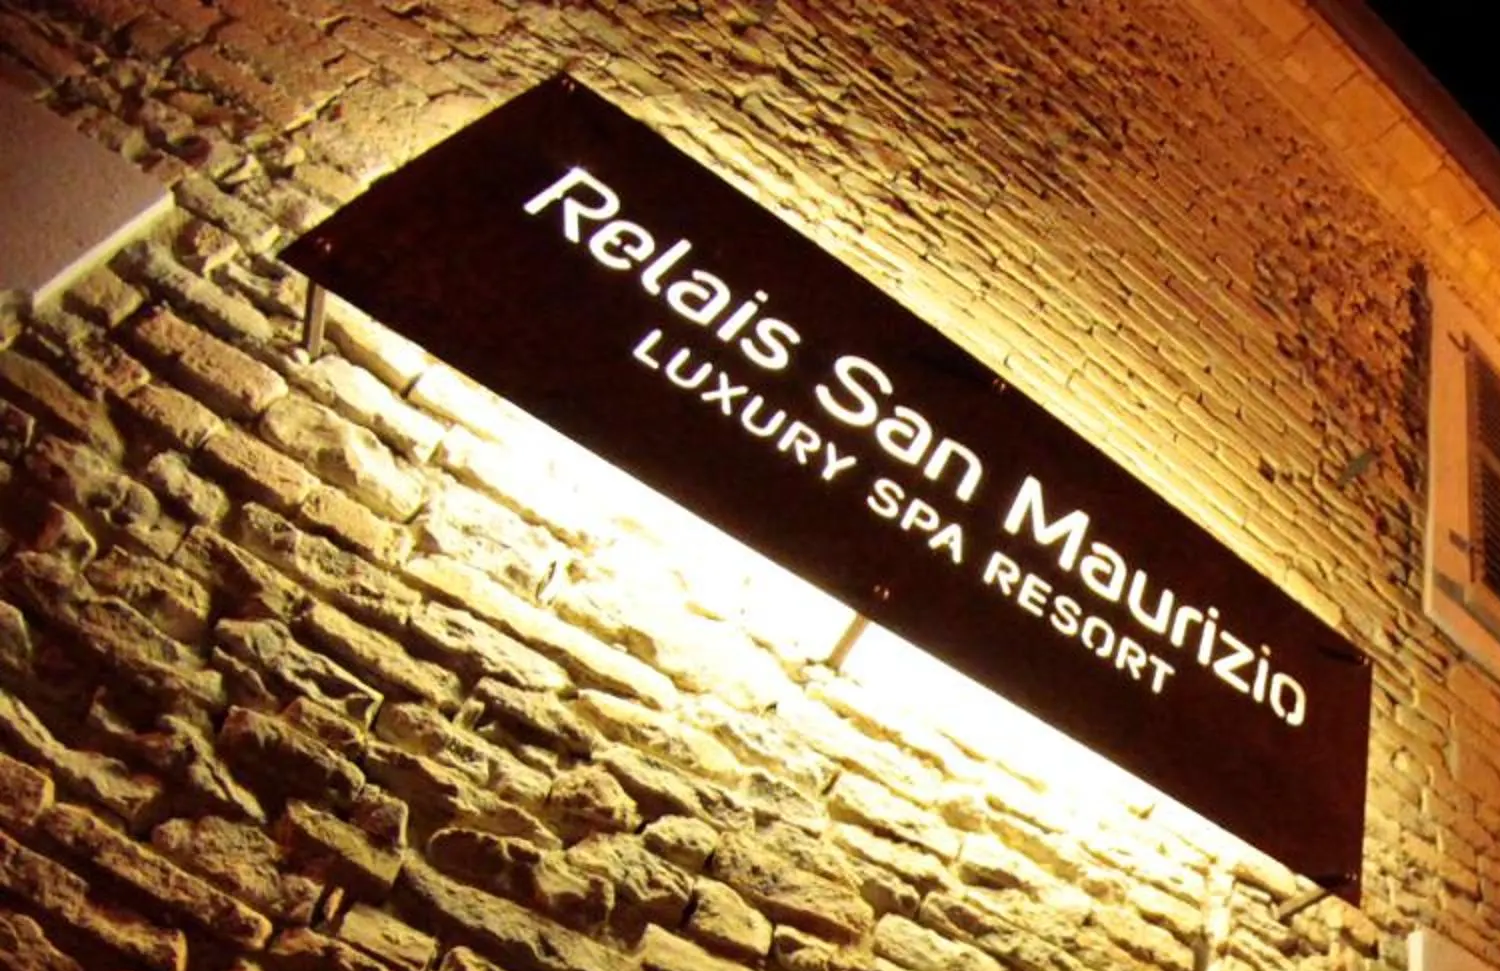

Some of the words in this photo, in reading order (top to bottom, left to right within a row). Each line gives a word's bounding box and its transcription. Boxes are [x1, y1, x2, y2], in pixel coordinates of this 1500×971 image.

[523, 166, 801, 371] Relais
[815, 355, 983, 502] San
[1003, 475, 1306, 726] Maurizio
[632, 329, 857, 481] LUXURY
[866, 477, 963, 564] SPA
[982, 551, 1176, 694] RESORT
